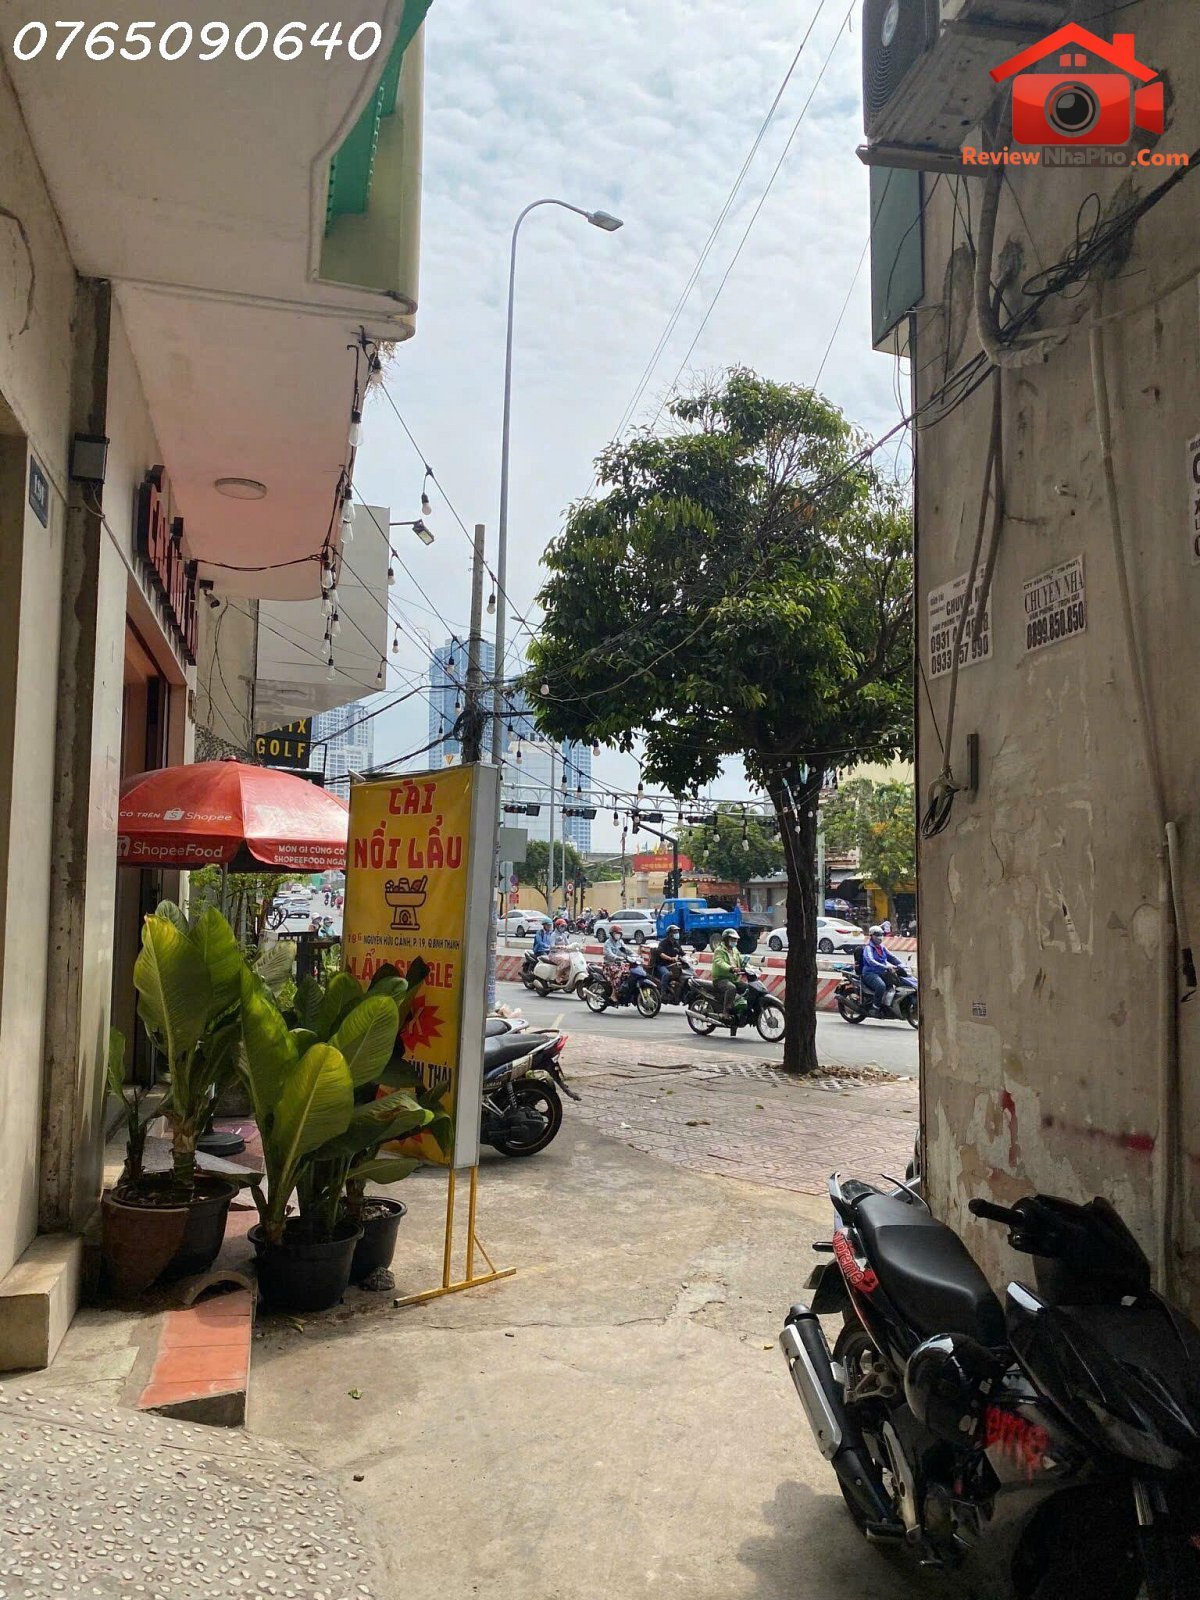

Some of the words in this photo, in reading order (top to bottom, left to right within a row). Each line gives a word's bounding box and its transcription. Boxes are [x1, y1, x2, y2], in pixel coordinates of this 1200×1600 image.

[931, 649, 952, 675] 0933
[256, 738, 306, 758] GOLF
[185, 812, 232, 822] Shopee
[133, 842, 223, 858] ShopeeFood
[274, 856, 325, 865] SHOPEEFOOD
[395, 959, 454, 988] SGLE
